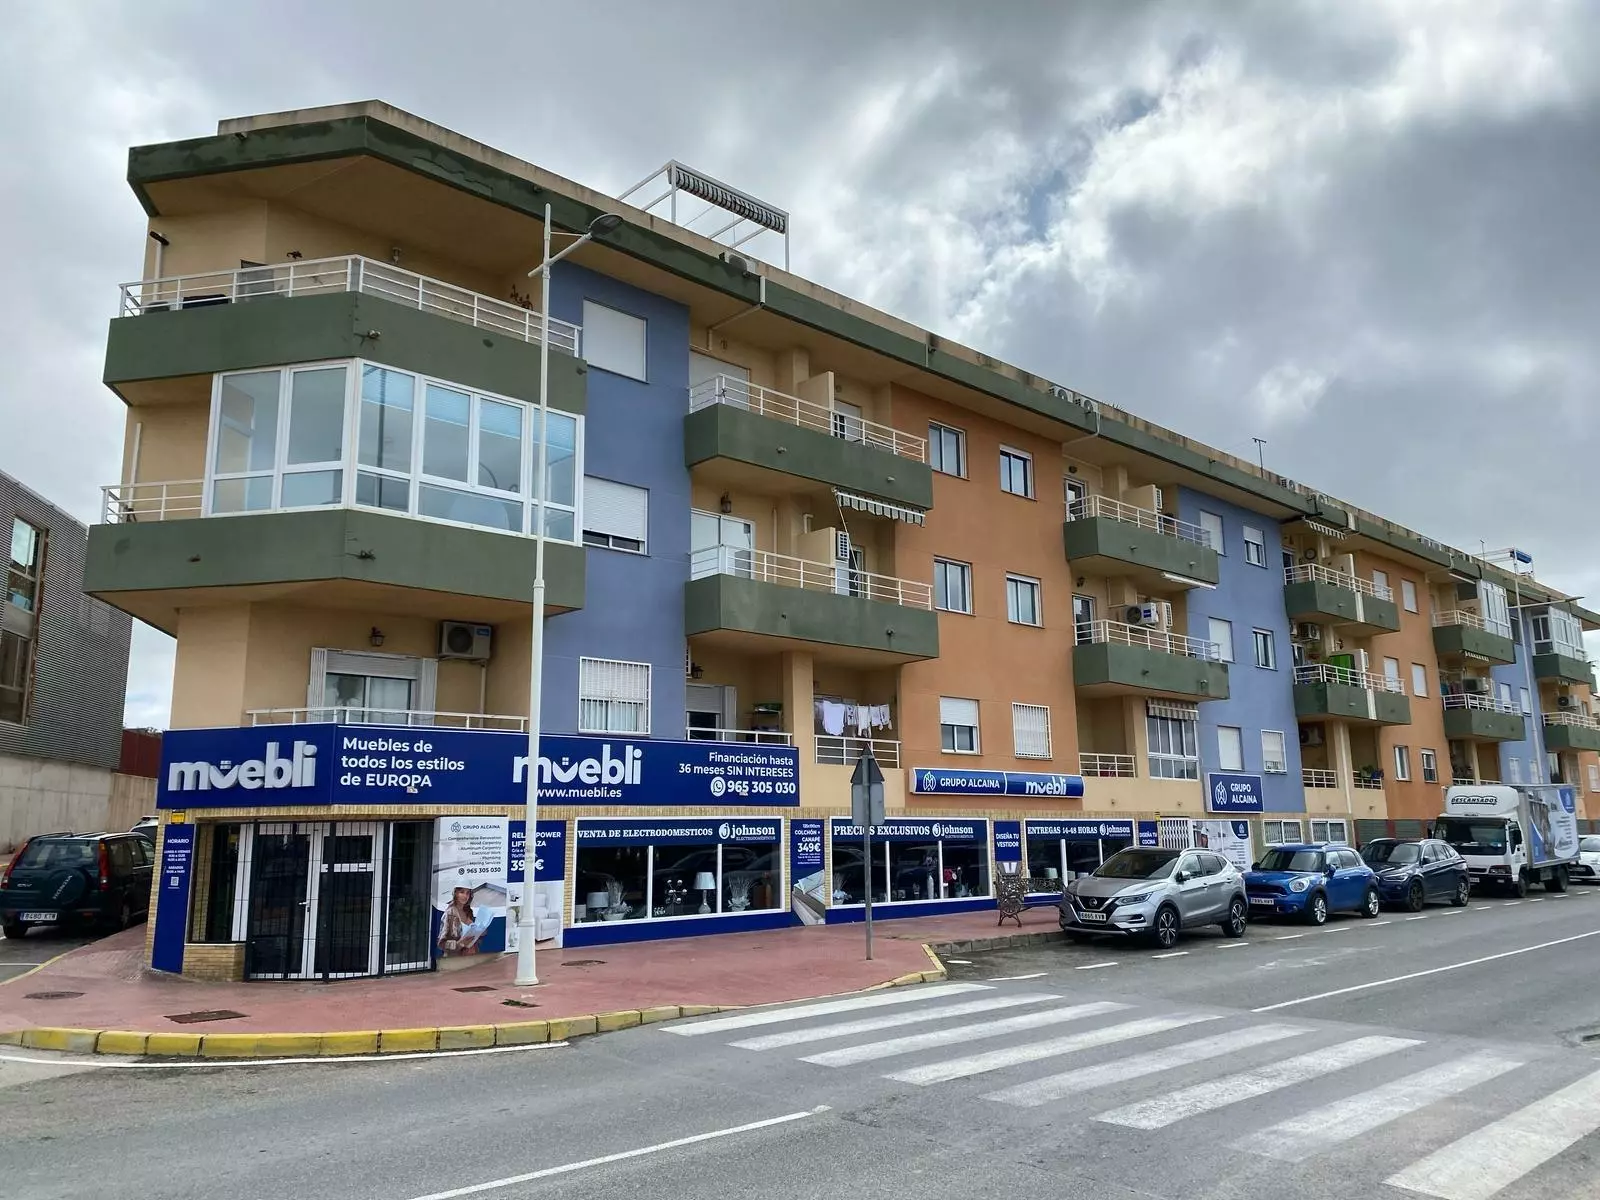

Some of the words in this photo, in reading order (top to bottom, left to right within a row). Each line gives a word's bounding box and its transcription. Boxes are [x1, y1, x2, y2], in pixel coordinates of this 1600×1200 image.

[343, 737, 410, 752] Muebles
[413, 740, 433, 753] de
[341, 755, 387, 769] todos
[391, 756, 413, 770] los
[416, 757, 465, 771] estilos
[709, 752, 768, 765] Financiación
[769, 755, 793, 766] hasta
[679, 763, 691, 774] 36
[694, 765, 725, 775] meses
[727, 766, 743, 776] SIN
[745, 767, 794, 778] INTERESES
[340, 772, 361, 786] de
[365, 773, 432, 787] EUROPA
[940, 777, 967, 787] GRUPO
[968, 779, 1000, 789] ALCAINA
[727, 780, 749, 793] 965
[751, 781, 773, 794] 305
[775, 782, 796, 794] 030
[1230, 783, 1251, 792] GRUPO
[1232, 795, 1258, 804] ALCAINA
[577, 830, 607, 838] VENTA
[608, 829, 621, 838] DE
[622, 828, 713, 838] ELECTRODOMESTICOS
[730, 824, 775, 839] johnson
[877, 825, 930, 836] EXCLUSIVOS
[941, 824, 974, 837] johnson
[996, 832, 1013, 840] DISEÑA
[1027, 826, 1061, 835] ENTREGAS
[1078, 826, 1098, 835] HORAS
[1106, 823, 1131, 836] johnson
[797, 843, 821, 853] 349€
[511, 859, 544, 872] 39€
